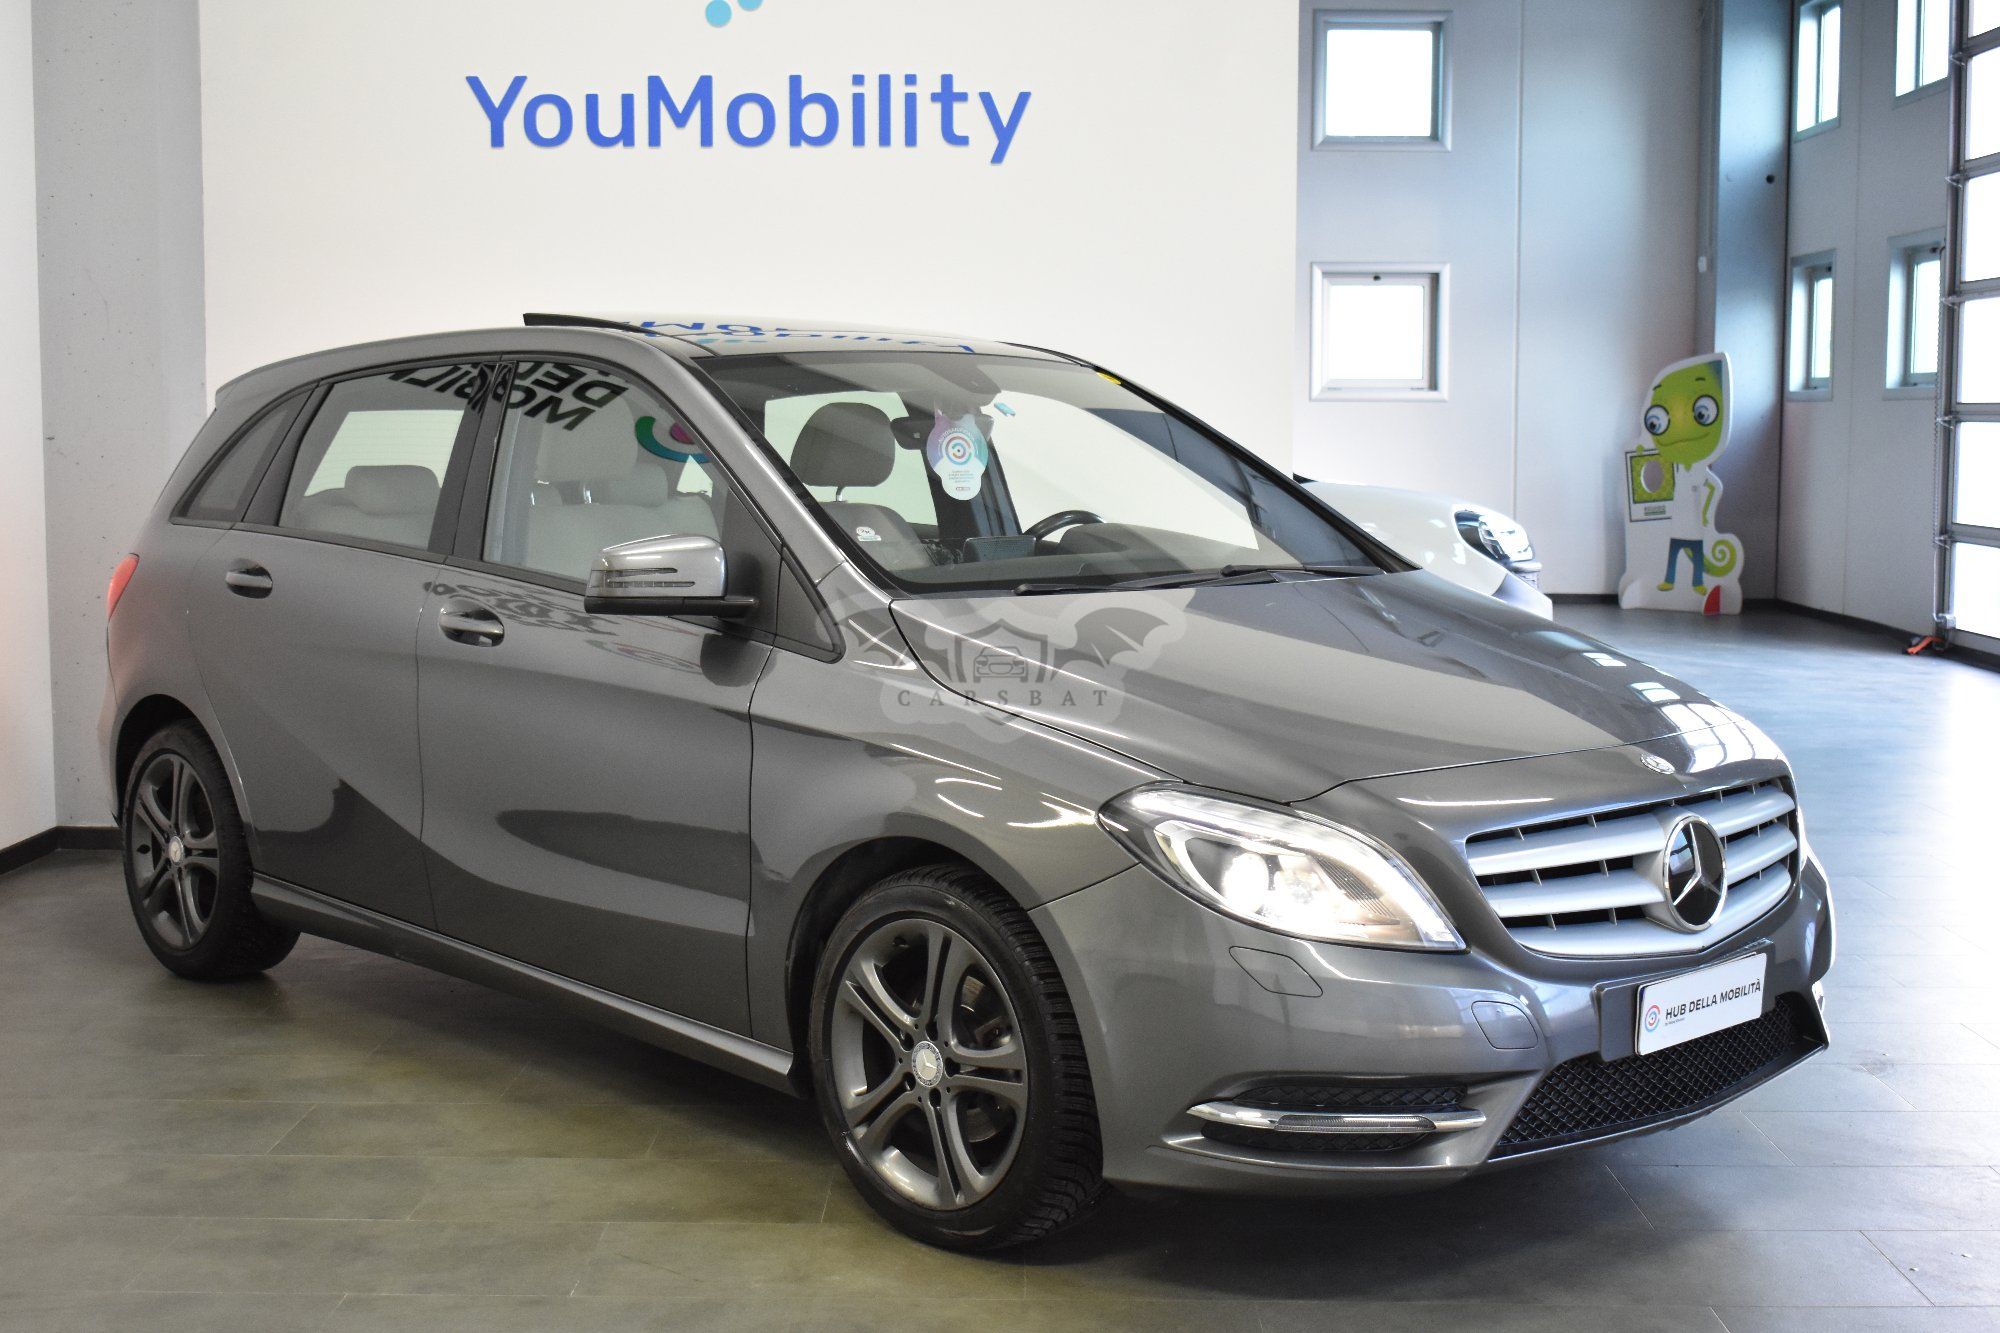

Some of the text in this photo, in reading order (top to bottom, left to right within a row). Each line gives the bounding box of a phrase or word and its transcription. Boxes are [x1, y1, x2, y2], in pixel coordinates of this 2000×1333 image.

[465, 73, 1032, 165] YouMobility
[1665, 978, 1762, 1021] HUB DELLA MOBILITÀ
